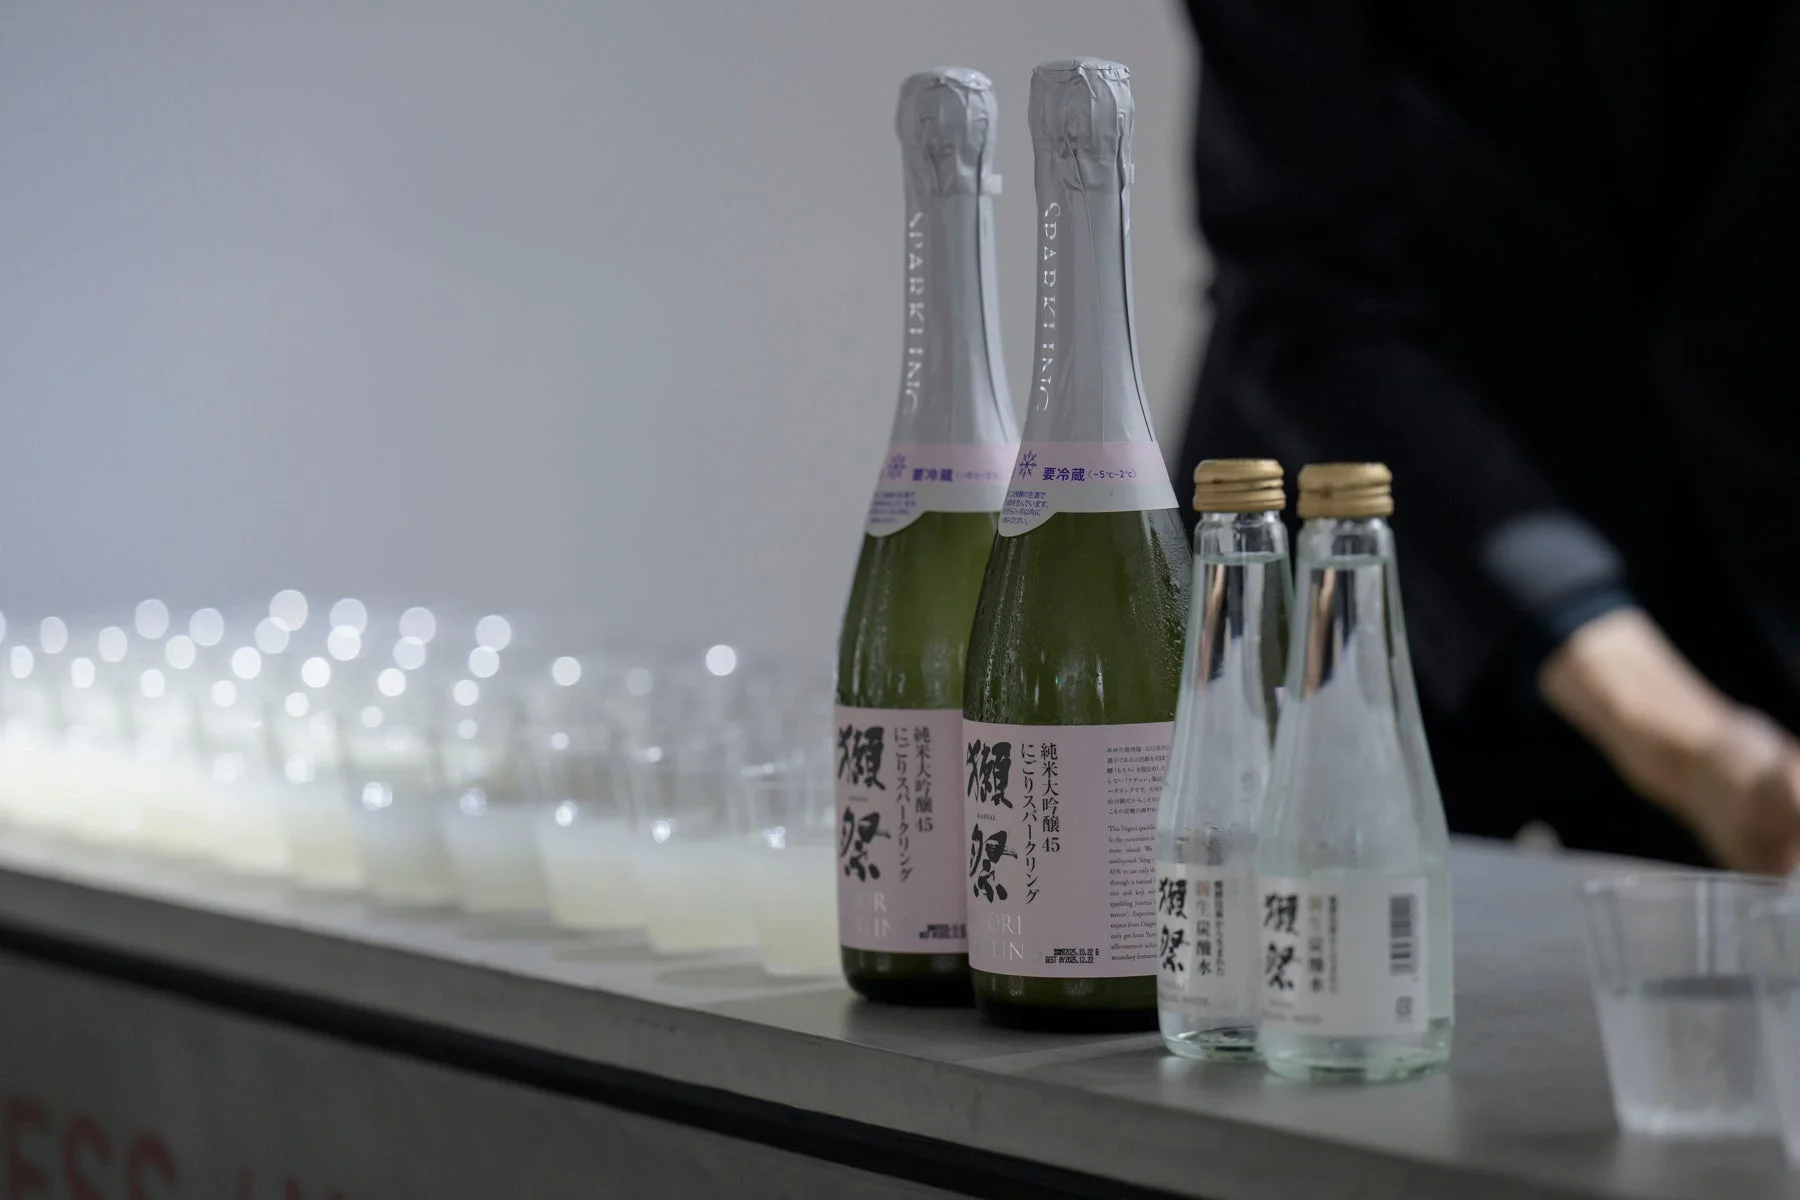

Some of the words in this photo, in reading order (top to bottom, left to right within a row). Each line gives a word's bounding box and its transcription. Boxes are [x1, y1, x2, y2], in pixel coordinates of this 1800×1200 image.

[1042, 467, 1085, 481] 要冷蔵
[838, 724, 891, 882] 獺祭
[893, 727, 913, 882] にごりスパークリング
[913, 726, 933, 814] 純米大吟醸
[1040, 743, 1060, 834] 純米大吟醸
[915, 817, 934, 834] 45
[966, 739, 1018, 903] 獺祭
[1021, 744, 1040, 904] にごりスパークリング
[1042, 837, 1060, 852] 45
[1111, 954, 1135, 962] secondary
